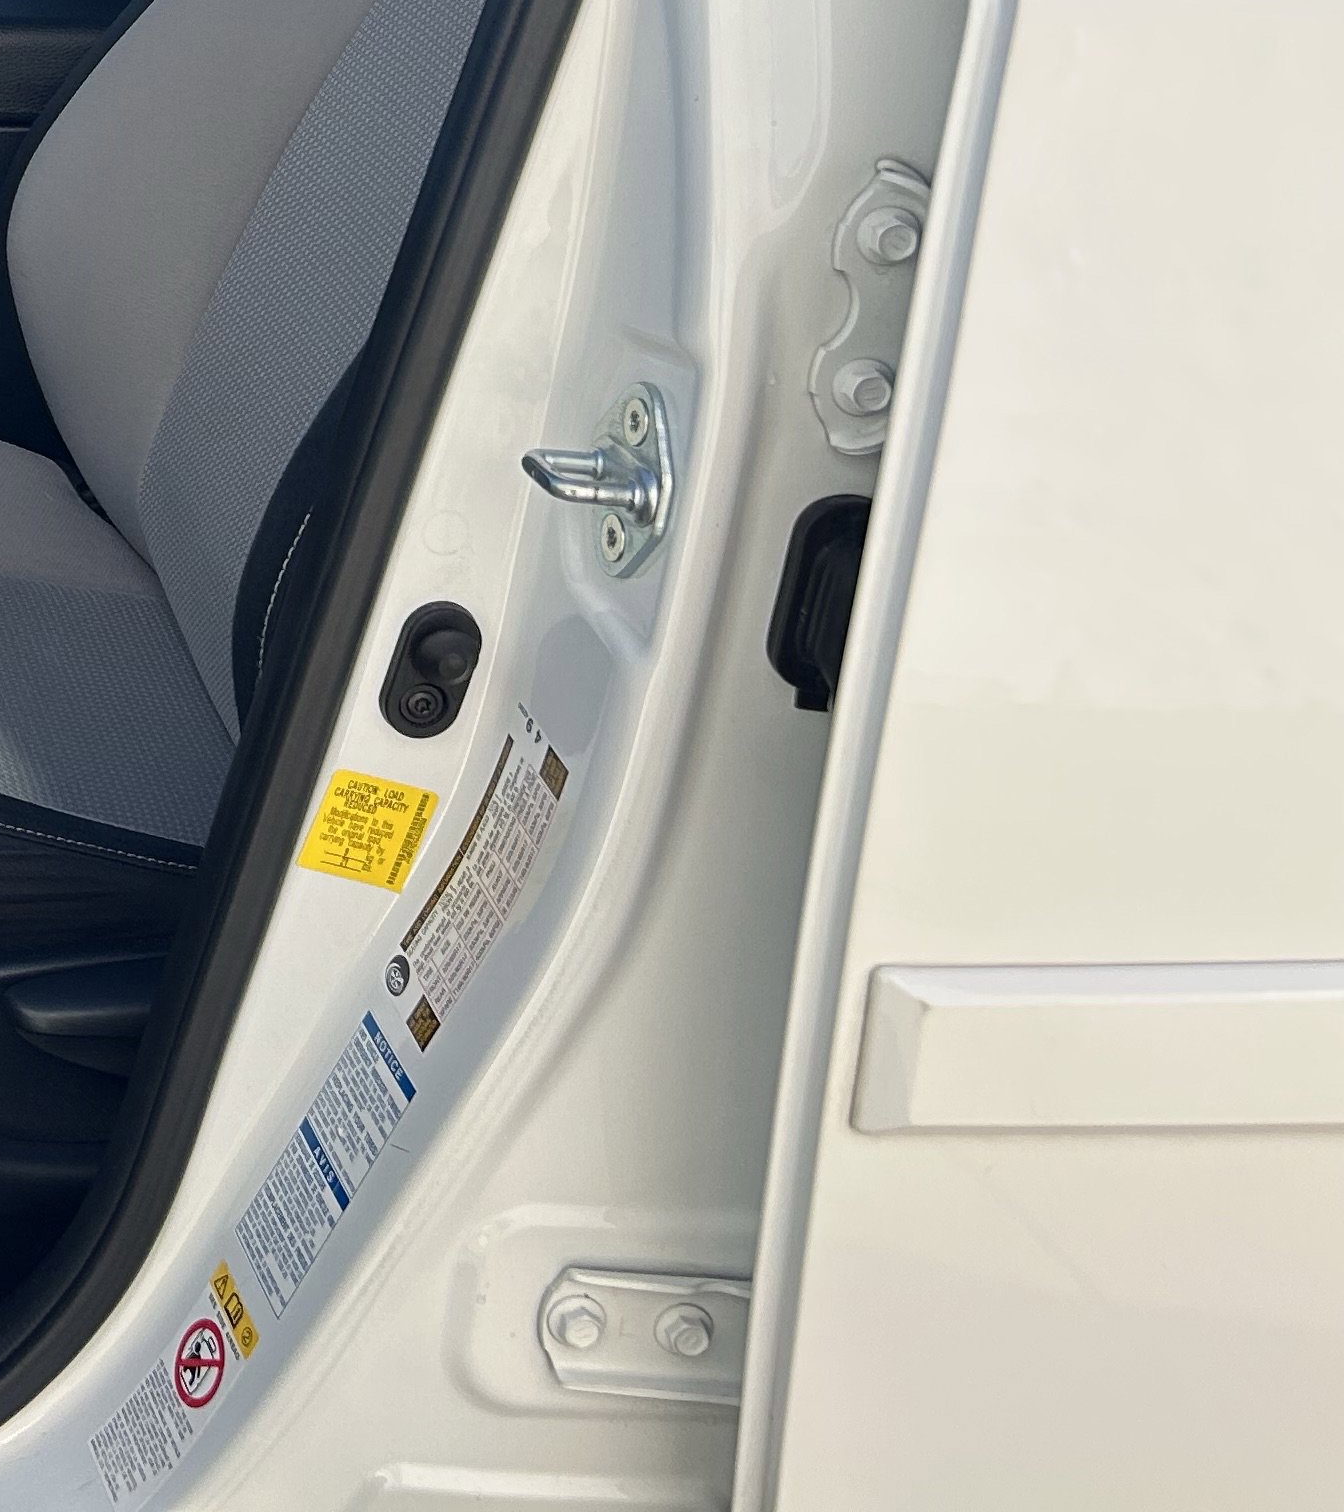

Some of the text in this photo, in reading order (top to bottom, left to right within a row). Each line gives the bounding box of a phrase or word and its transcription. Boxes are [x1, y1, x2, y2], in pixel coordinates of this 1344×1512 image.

[373, 796, 410, 814] CAPACITY
[373, 1030, 405, 1081] NOTICE
[312, 1145, 334, 1183] AVIS
